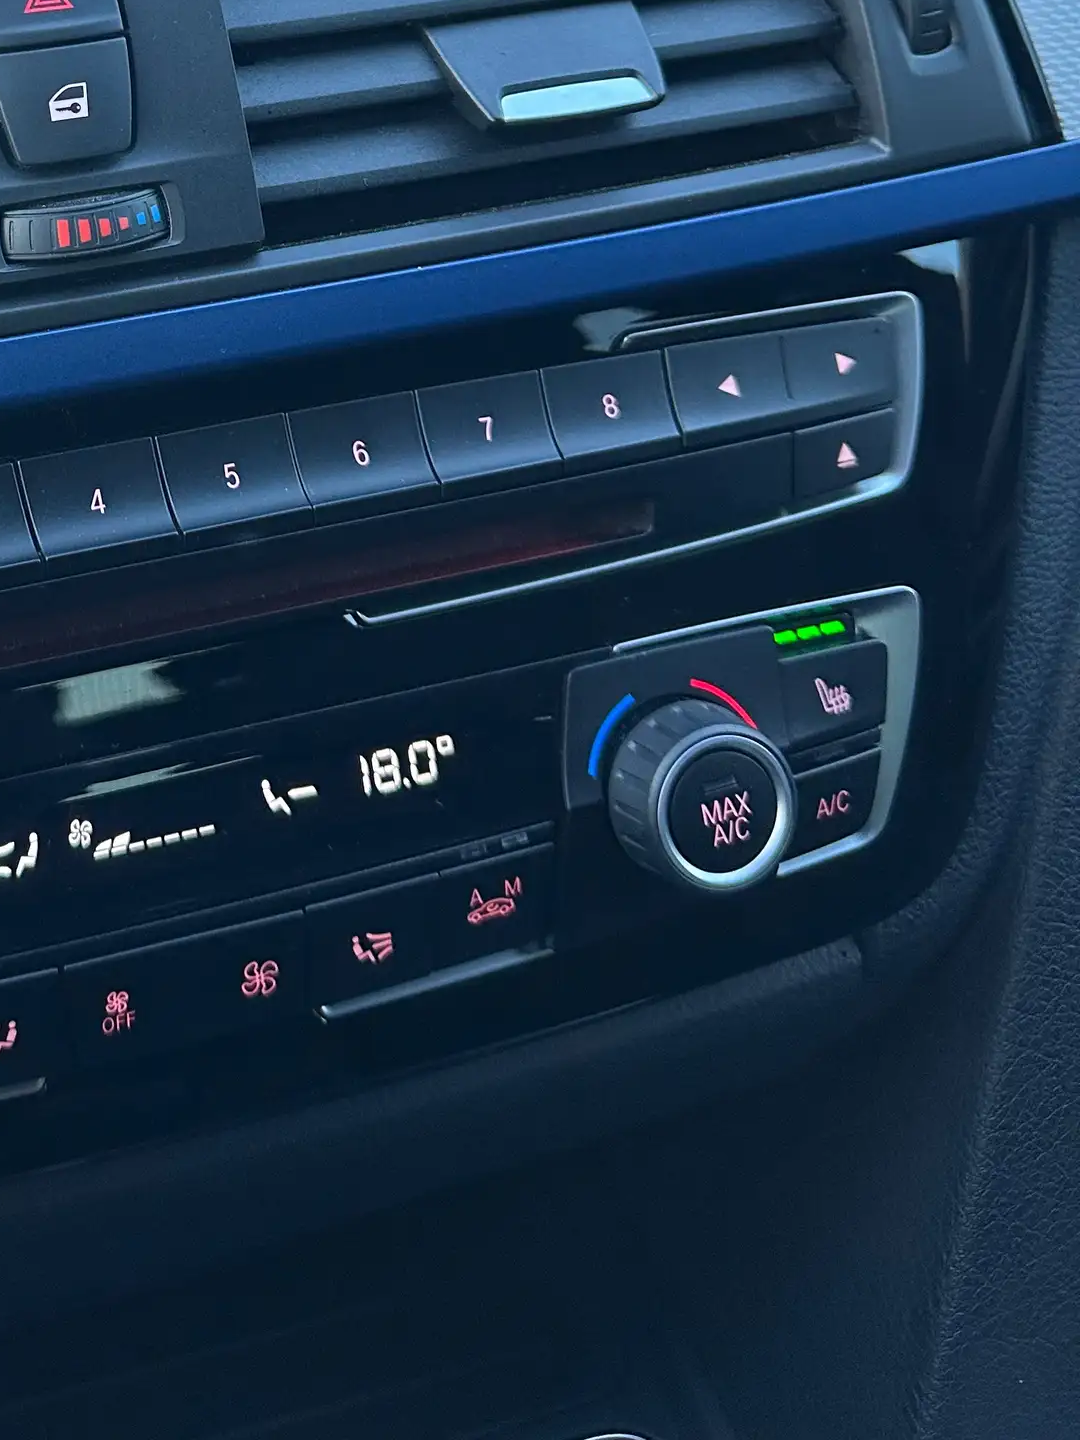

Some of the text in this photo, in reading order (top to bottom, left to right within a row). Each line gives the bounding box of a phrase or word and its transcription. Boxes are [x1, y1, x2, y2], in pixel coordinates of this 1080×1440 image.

[602, 393, 620, 419] 8
[477, 416, 494, 442] 7
[352, 440, 371, 466] 6
[223, 462, 241, 490] 5
[90, 489, 106, 514] 4
[700, 791, 753, 827] MAX
[816, 790, 851, 820] A/C
[714, 817, 750, 847] A/C
[469, 875, 523, 908] A M
[102, 1010, 137, 1035] OFF
